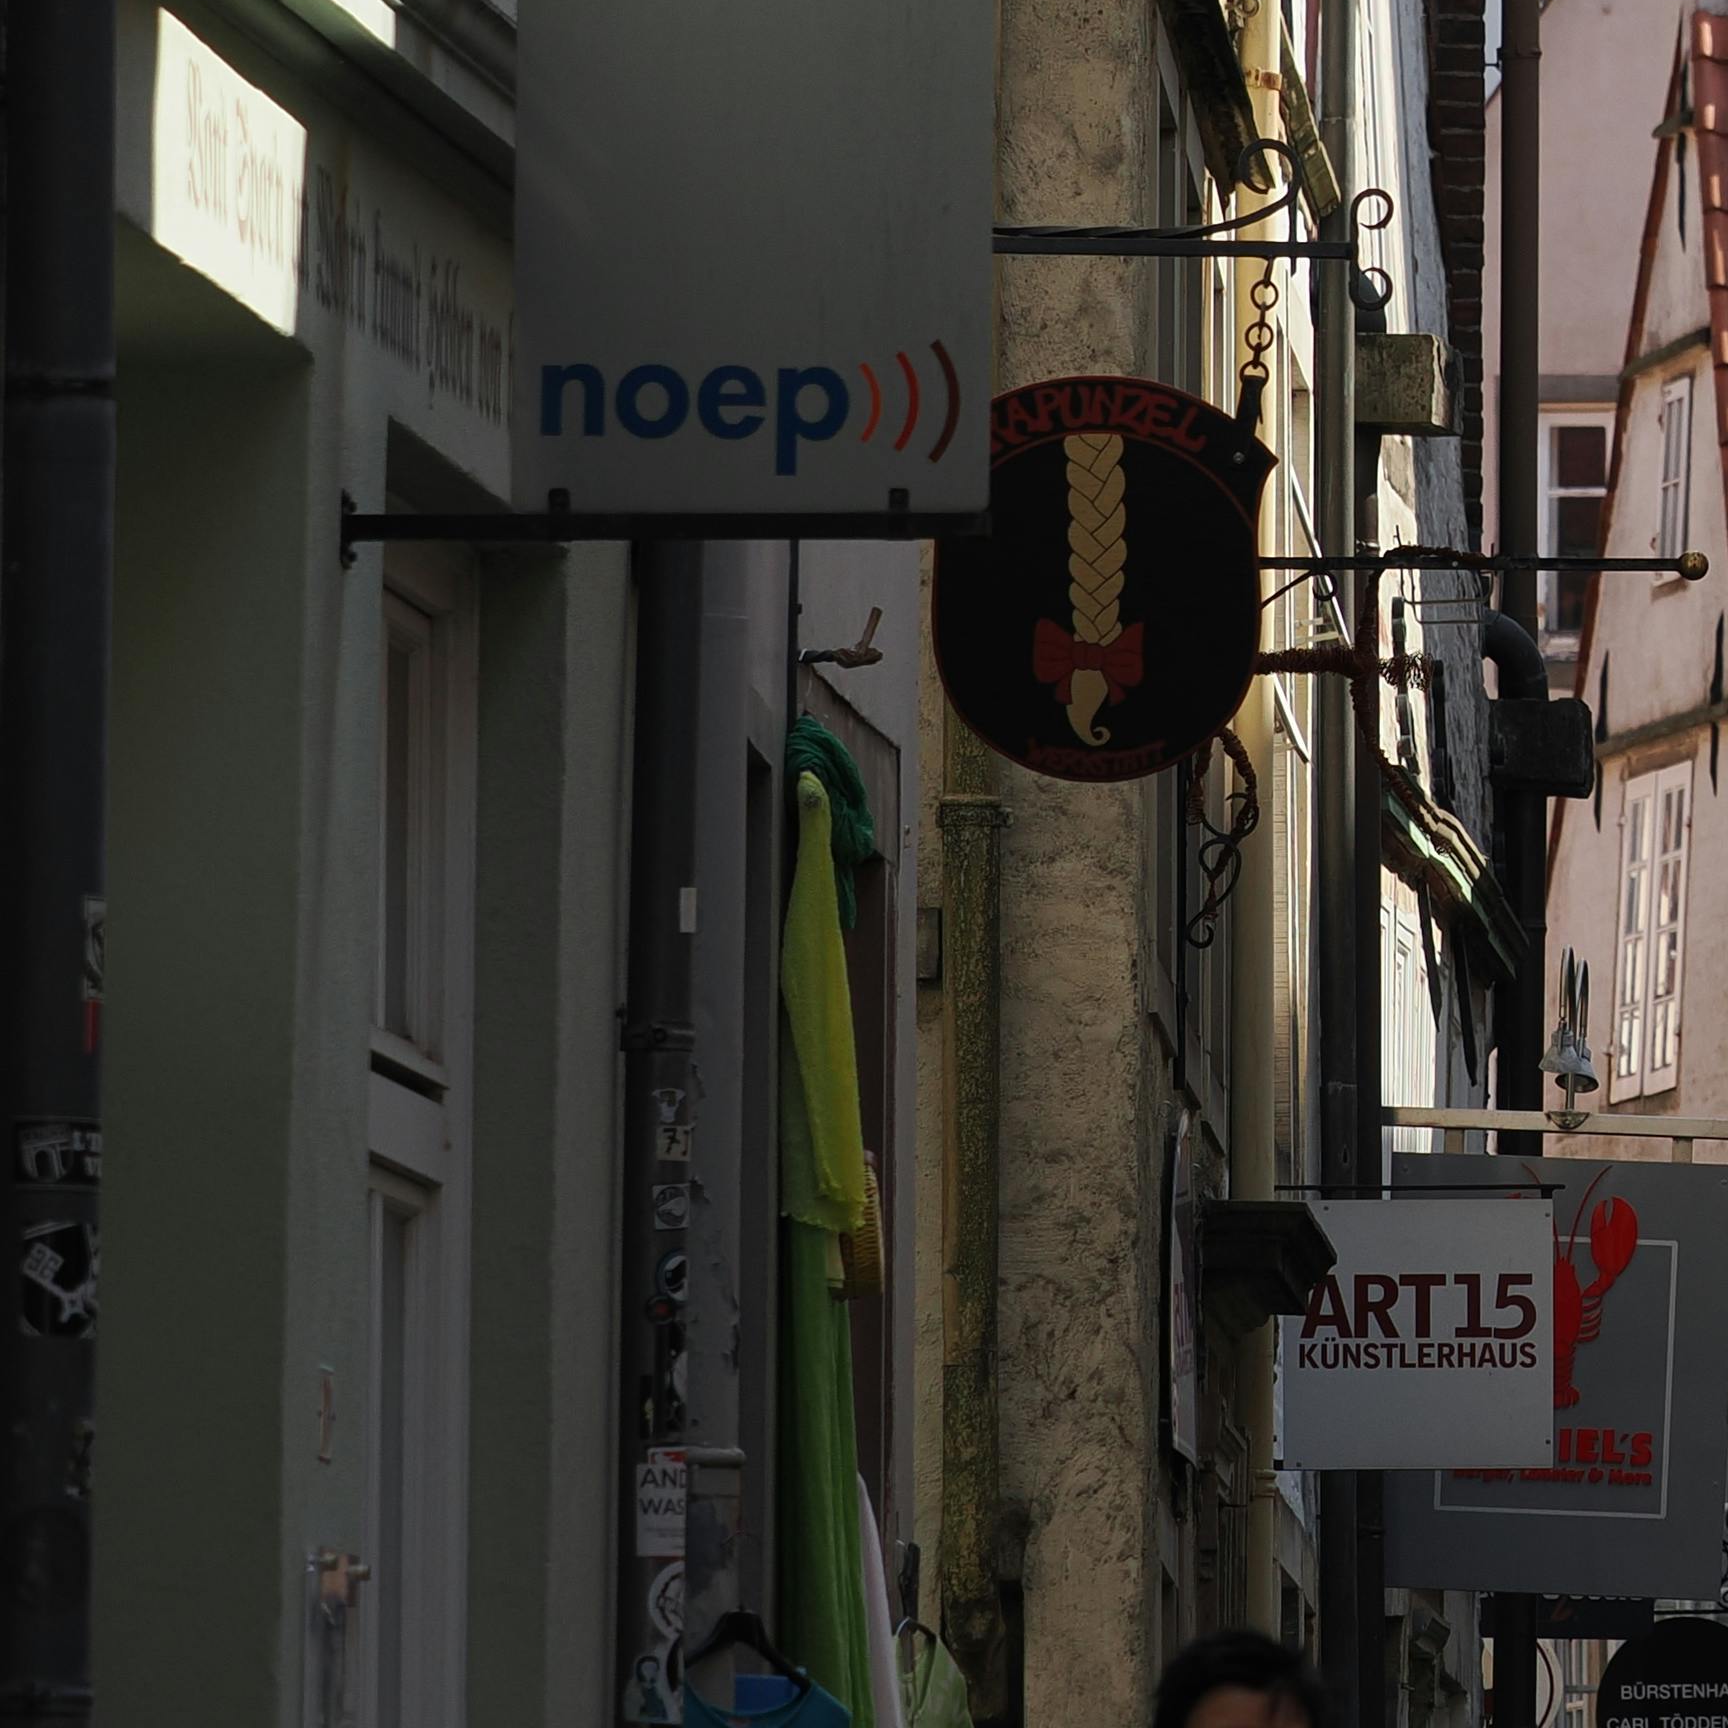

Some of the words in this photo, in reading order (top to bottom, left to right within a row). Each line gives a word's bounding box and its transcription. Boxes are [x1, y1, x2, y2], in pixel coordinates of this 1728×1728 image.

[540, 362, 849, 476] noep
[1025, 736, 1168, 776] WERKSTATT
[1301, 1272, 1538, 1339] ART15
[1299, 1338, 1538, 1370] KÜNSTLERHAUS
[1558, 1427, 1654, 1467] IEL'S
